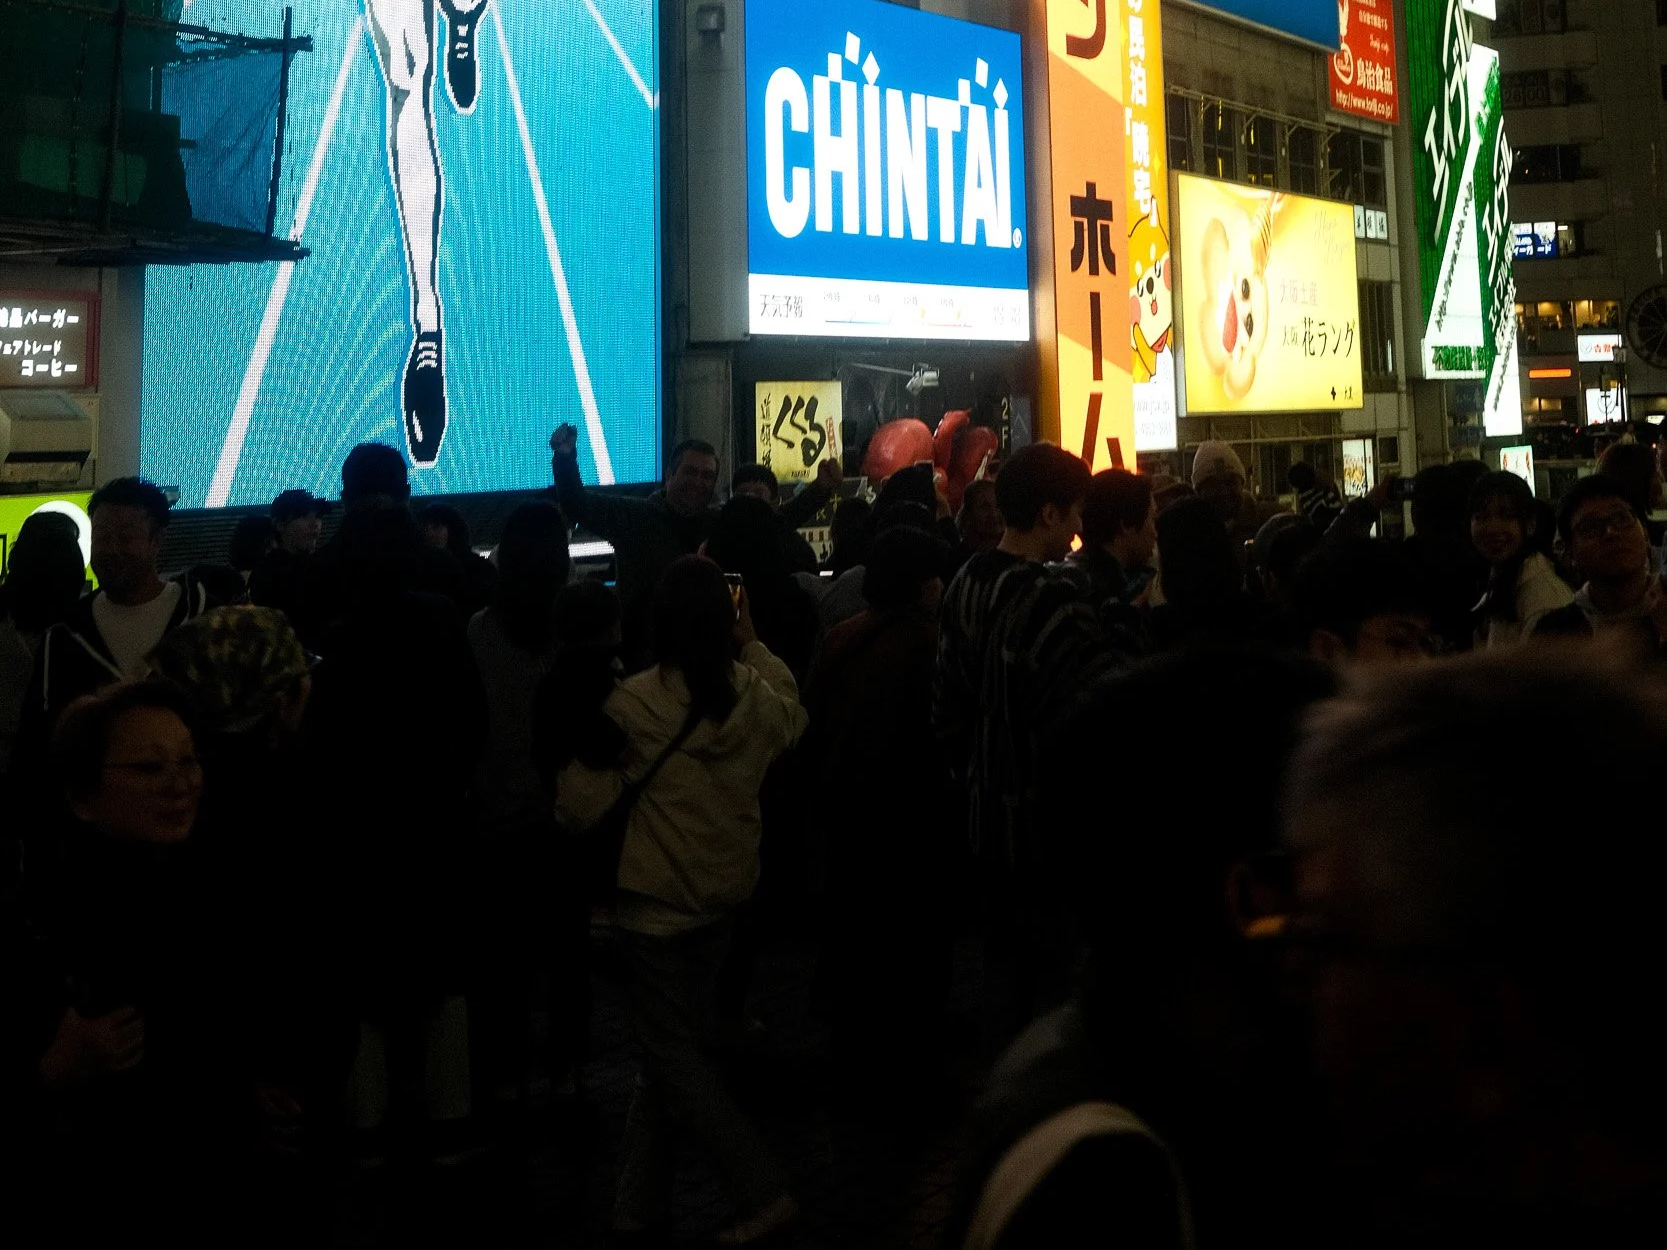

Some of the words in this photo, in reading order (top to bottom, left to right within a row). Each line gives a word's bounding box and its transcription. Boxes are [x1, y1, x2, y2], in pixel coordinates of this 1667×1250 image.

[764, 31, 1014, 249] CHINTAI
[1482, 130, 1513, 261] エイブル
[0, 338, 62, 356] ェアトレード
[21, 357, 77, 377] コーヒー
[772, 395, 826, 468] くくる
